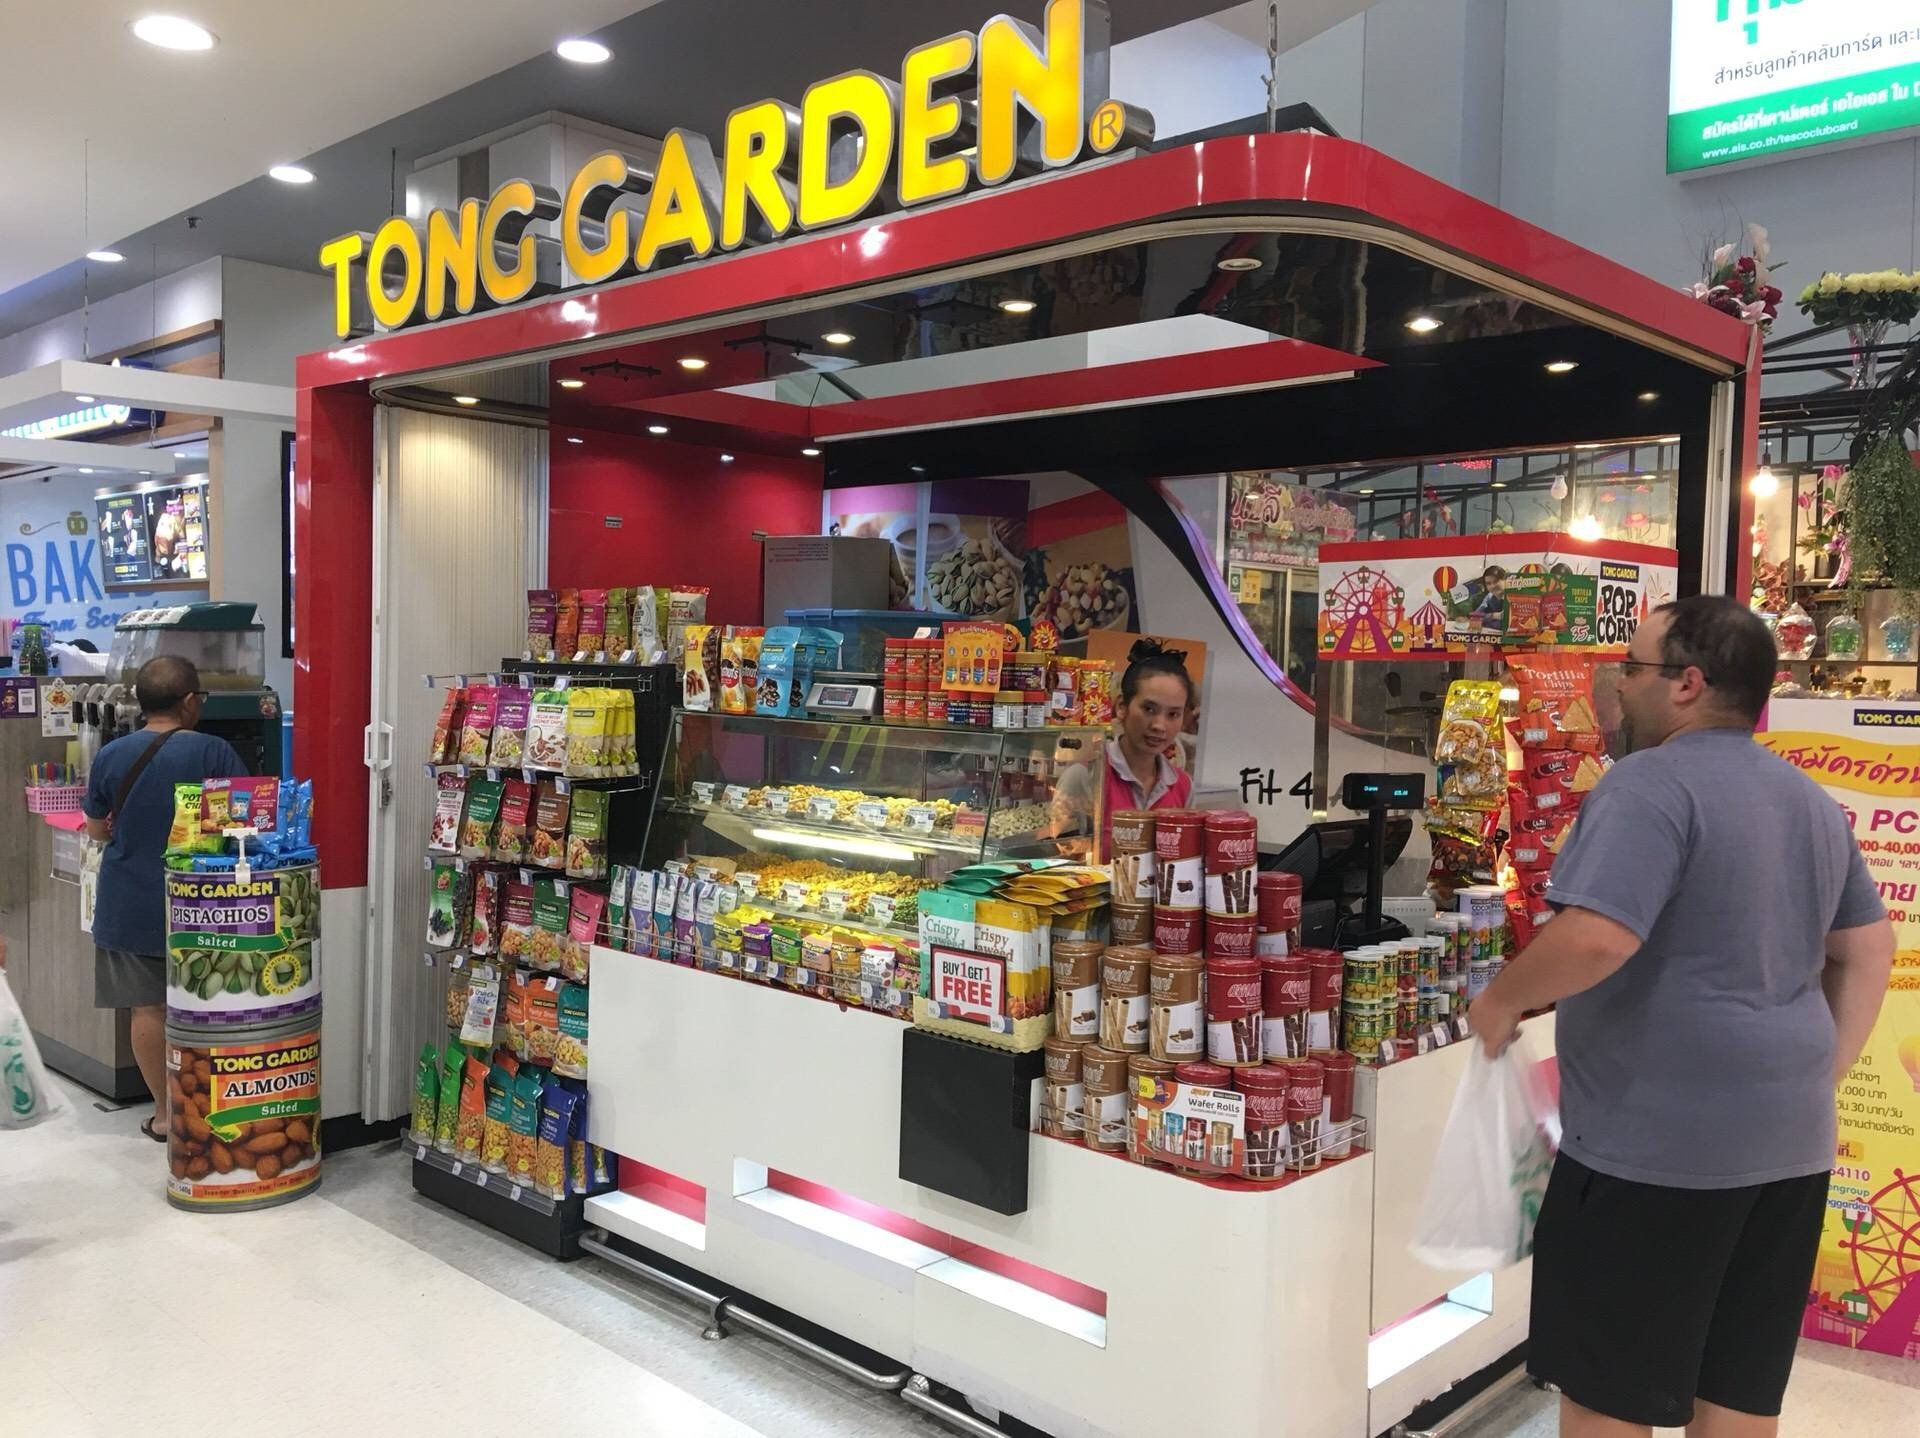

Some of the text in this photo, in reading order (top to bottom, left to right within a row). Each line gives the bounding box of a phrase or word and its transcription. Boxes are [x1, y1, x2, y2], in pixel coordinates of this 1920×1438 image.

[1702, 120, 1858, 160] www.ais.co.th/tescoclubcard
[318, 178, 537, 341] TONG
[561, 0, 1085, 285] GARDEN
[6, 539, 150, 607] BAK
[1601, 584, 1638, 617] POP
[1447, 634, 1471, 643] TONG
[1523, 668, 1585, 680] Tortilla
[1544, 680, 1574, 690] Chips
[1857, 713, 1892, 724] TONG
[1870, 809, 1919, 833] PC
[168, 881, 273, 898] TONG GARDEN
[172, 906, 269, 924] PISTACHIOS
[926, 918, 961, 938] Crispy
[975, 926, 1010, 949] Crispy
[197, 936, 237, 948] Salted
[942, 960, 992, 983] BUY 1 GET 1
[942, 976, 992, 1008] FREE
[214, 1043, 319, 1073] TONG GARDEN
[225, 1068, 316, 1097] ALMONDS
[261, 1102, 298, 1116] Salted
[1188, 1097, 1240, 1113] Wafer Rolls
[1851, 1102, 1865, 1113] 30
